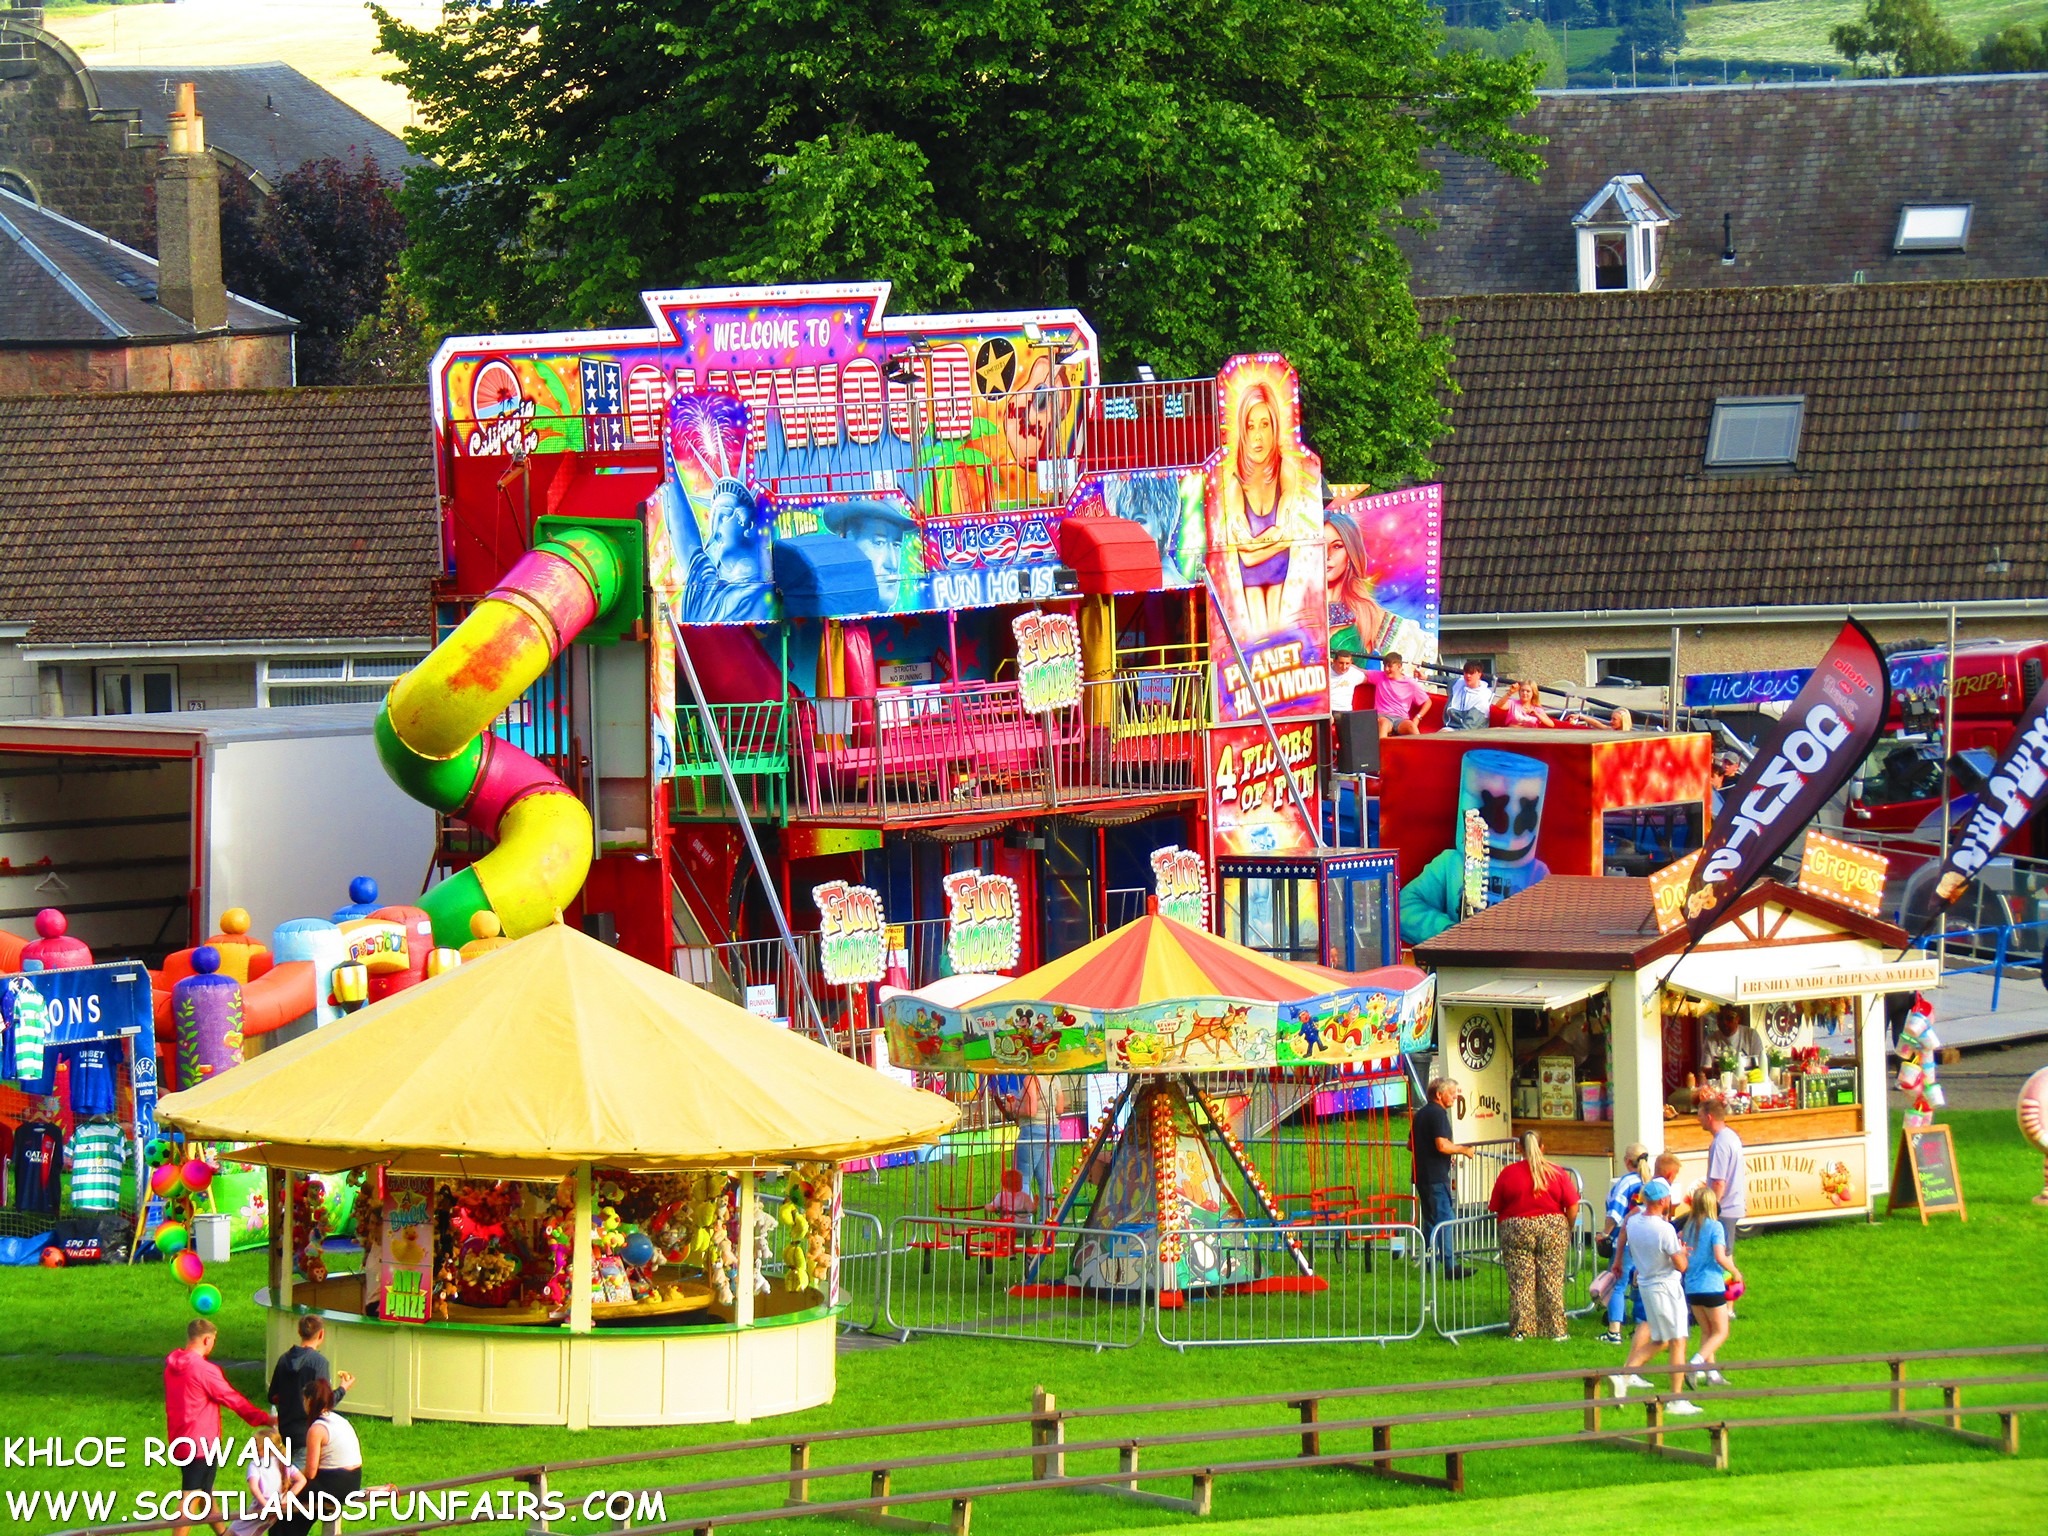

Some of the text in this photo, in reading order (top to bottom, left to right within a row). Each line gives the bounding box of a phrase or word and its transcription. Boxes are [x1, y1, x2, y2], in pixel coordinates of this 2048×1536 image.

[713, 318, 831, 352] WELCOME TO
[579, 343, 974, 451] HOYWOOD
[778, 511, 818, 539] LAS VEGAS
[939, 520, 1058, 570] USA
[934, 566, 1062, 607] FUN HOUS
[1018, 616, 1075, 668] Fun
[890, 673, 923, 683] NO RUNNING
[893, 664, 919, 673] STRICTLY
[1709, 675, 1800, 701] Hickeys
[1890, 667, 1912, 687] er
[1216, 725, 1313, 804] 4 FLOORS
[1241, 780, 1267, 813] OF
[692, 838, 715, 865] ONE WAY
[1155, 854, 1201, 898] Fun
[1808, 846, 1882, 894] Crepes
[820, 886, 880, 936] Fun
[951, 876, 1014, 925] Fun
[757, 988, 766, 997] NO
[1743, 979, 1790, 993] FRESHLY
[1795, 976, 1827, 989] MADE
[1829, 973, 1871, 987] CREPES
[1885, 967, 1936, 983] WAFFLES
[50, 994, 101, 1027] ONS
[749, 998, 775, 1008] RUNNING
[79, 1050, 105, 1059] UBET
[136, 1061, 154, 1075] UEFA
[1462, 1046, 1493, 1069] WAFFLES
[1744, 1155, 1817, 1175] SHLY MADE
[387, 1175, 431, 1194] HOOK
[1749, 1177, 1790, 1192] CREPES
[1752, 1195, 1801, 1210] WAFFLES
[388, 1202, 431, 1232] DUCK
[65, 1238, 98, 1248] SPOTS
[393, 1269, 423, 1294] ANY
[386, 1293, 426, 1320] PRIZE
